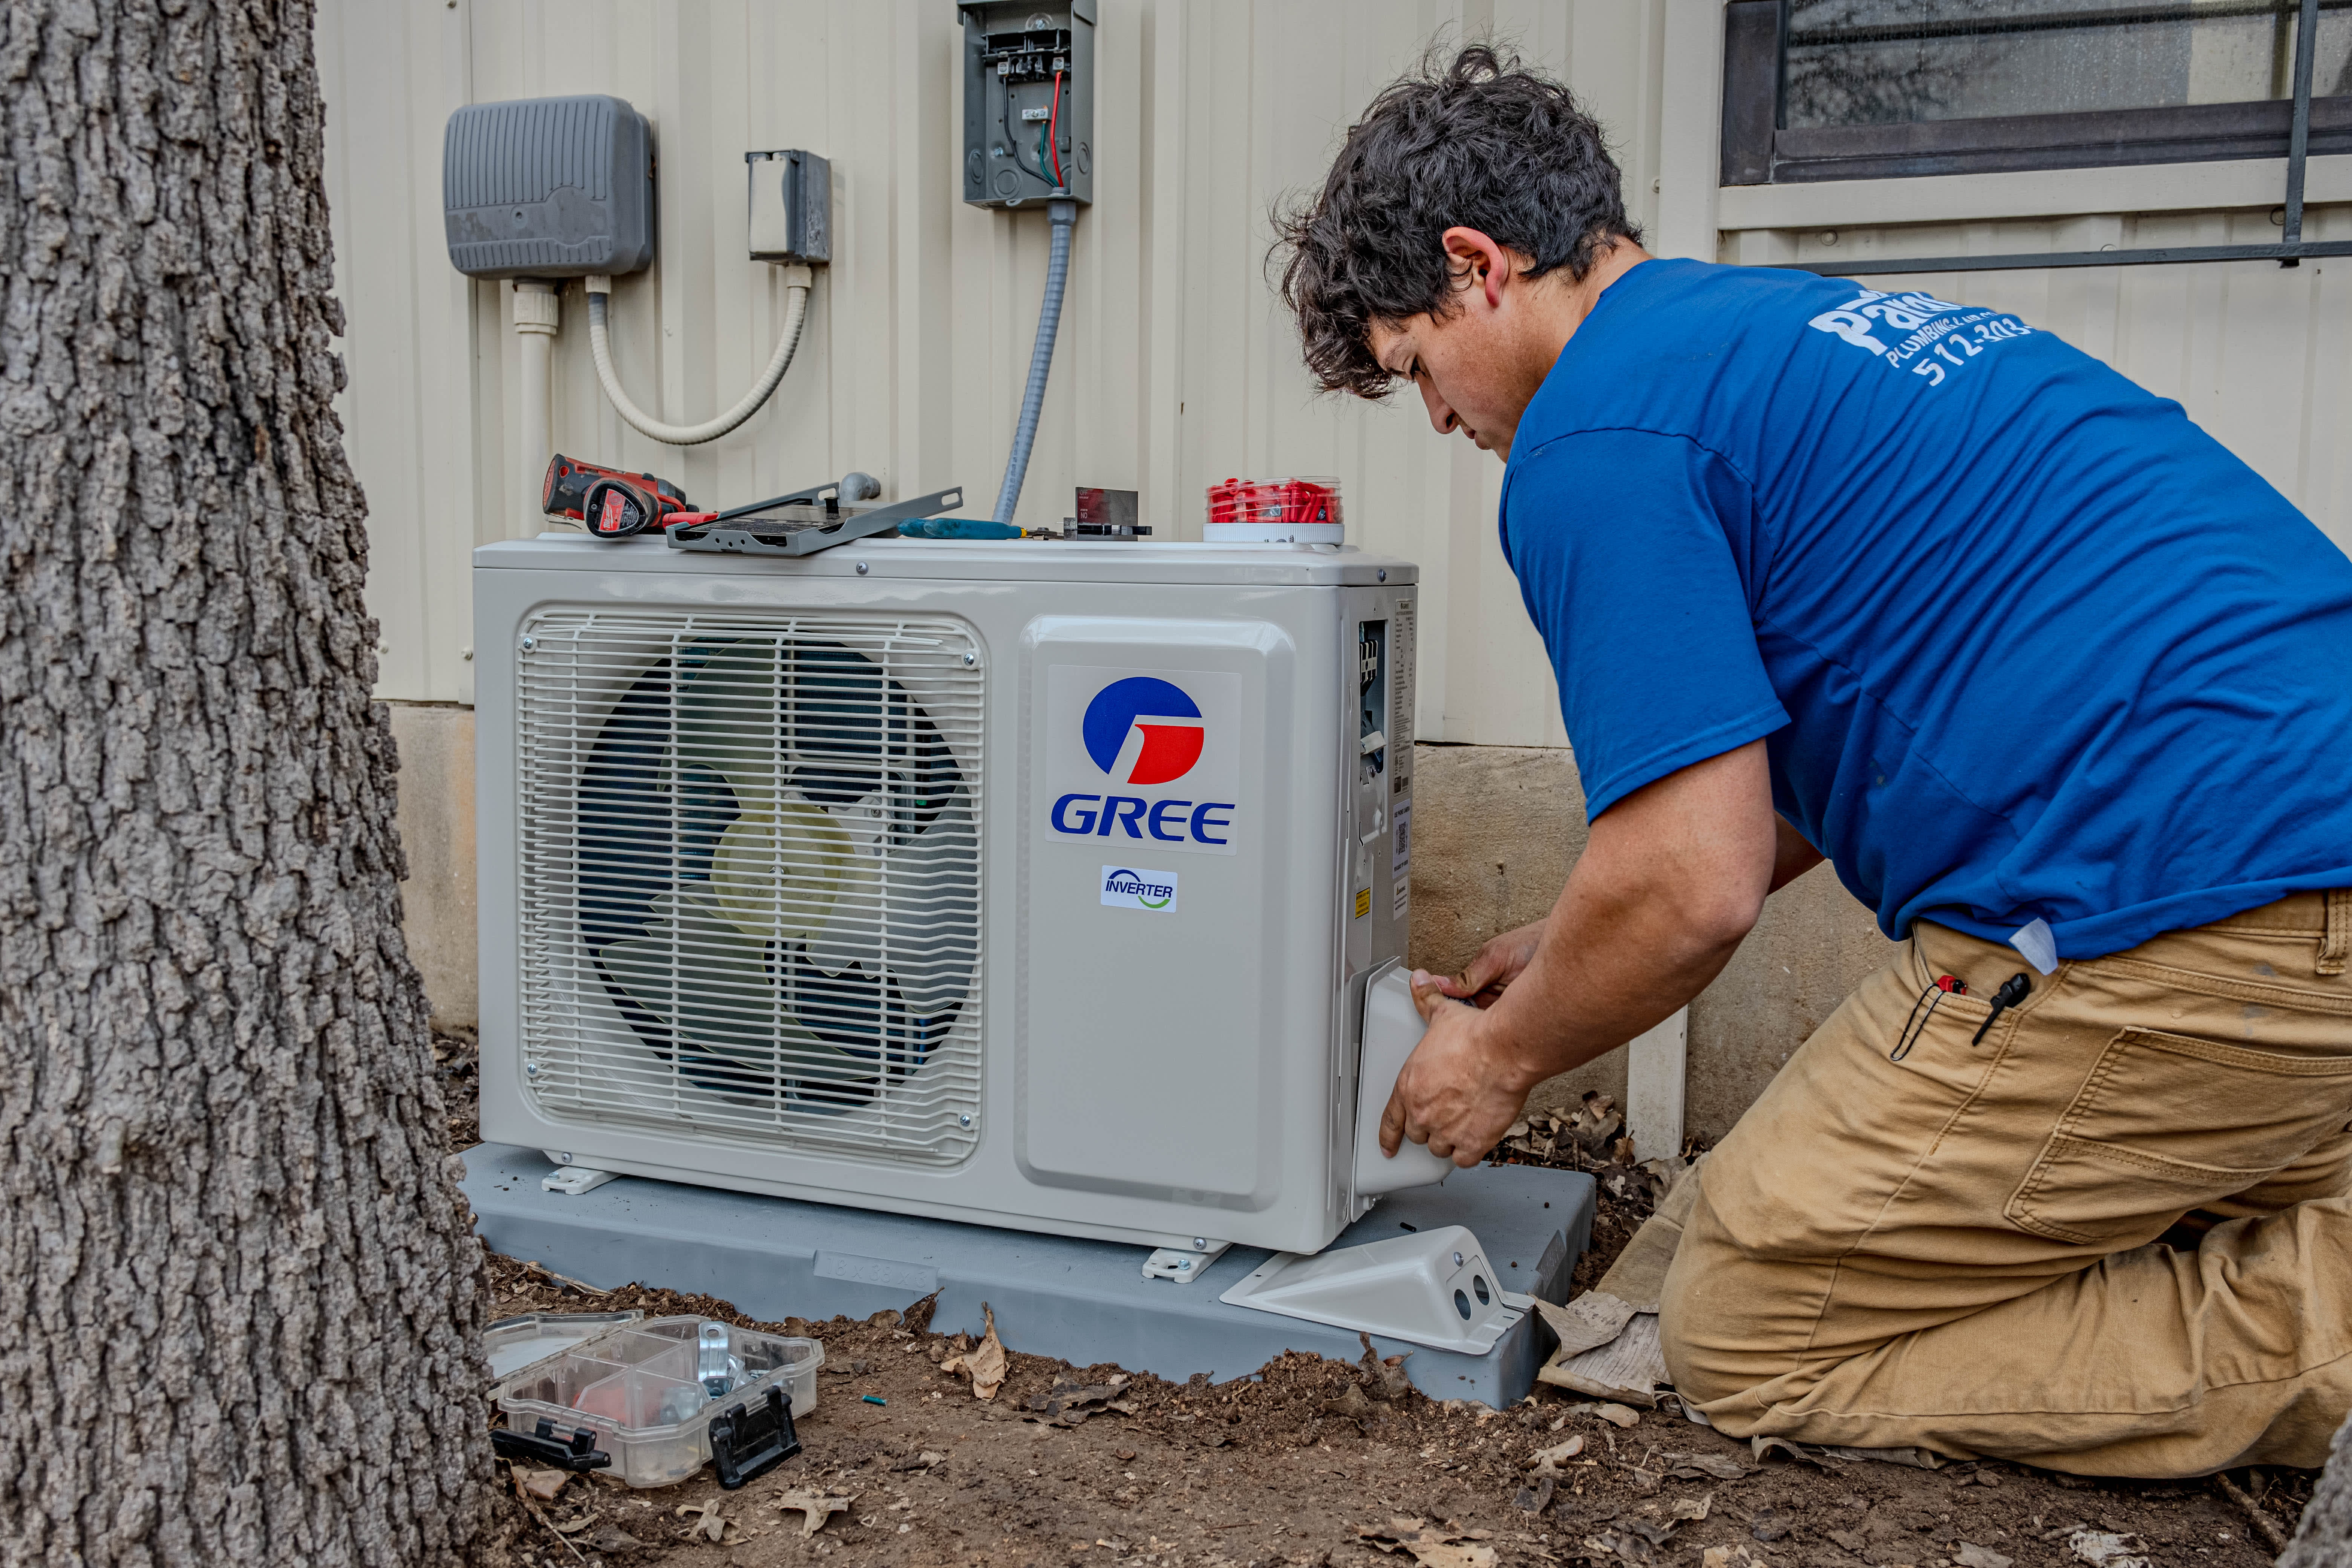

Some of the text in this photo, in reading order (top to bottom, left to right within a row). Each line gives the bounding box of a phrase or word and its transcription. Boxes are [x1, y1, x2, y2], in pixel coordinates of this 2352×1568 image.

[1885, 318, 1959, 369] PLUMBING
[1051, 793, 1235, 845] GREE
[1105, 880, 1173, 898] INVERTER
[827, 1257, 847, 1276] 18
